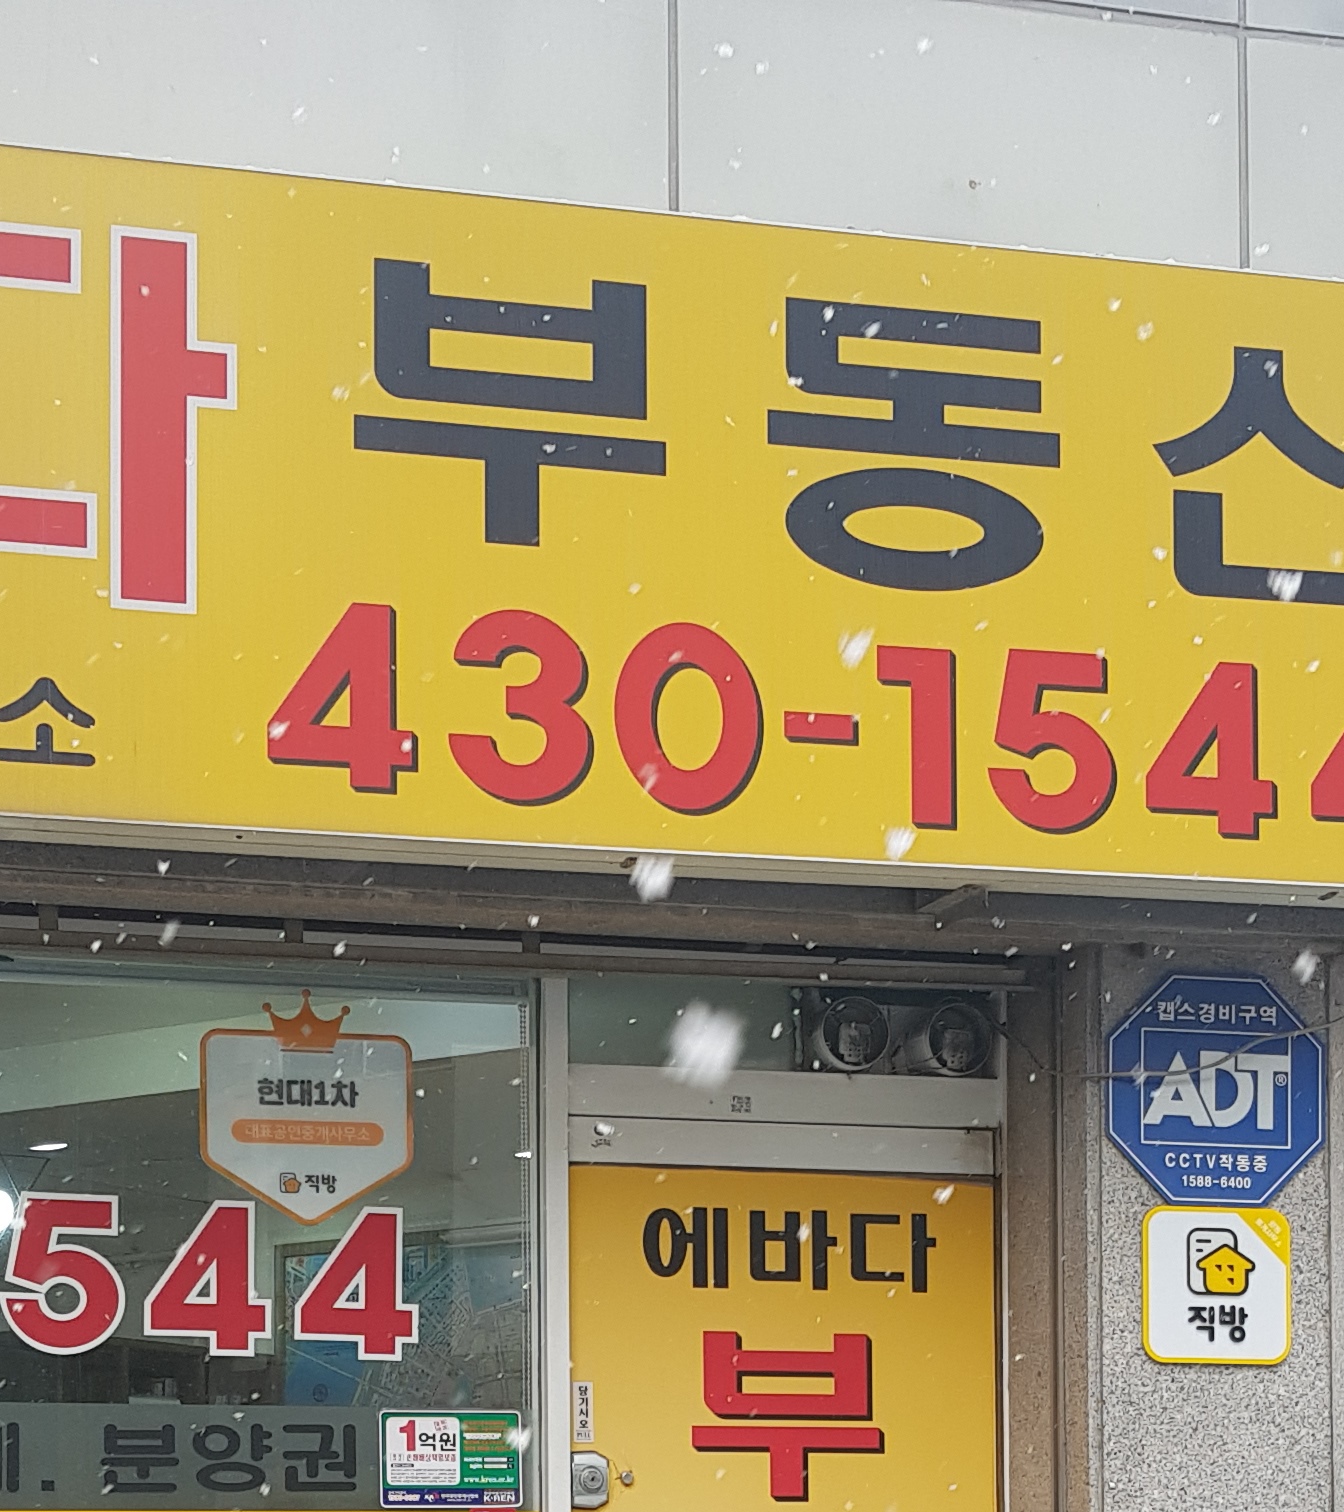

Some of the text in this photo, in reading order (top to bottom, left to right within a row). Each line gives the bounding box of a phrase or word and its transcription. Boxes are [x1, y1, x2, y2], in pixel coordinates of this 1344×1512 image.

[257, 1077, 359, 1107] 현대1차
[1143, 1050, 1288, 1131] ADT
[245, 1124, 370, 1144] 대표공인중개사무소
[304, 1174, 338, 1194] 직방
[1181, 1174, 1252, 1189] 1588-6400
[642, 1206, 937, 1293] 에바다
[1187, 1304, 1249, 1344] 직방
[100, 1424, 359, 1496] 분양권
